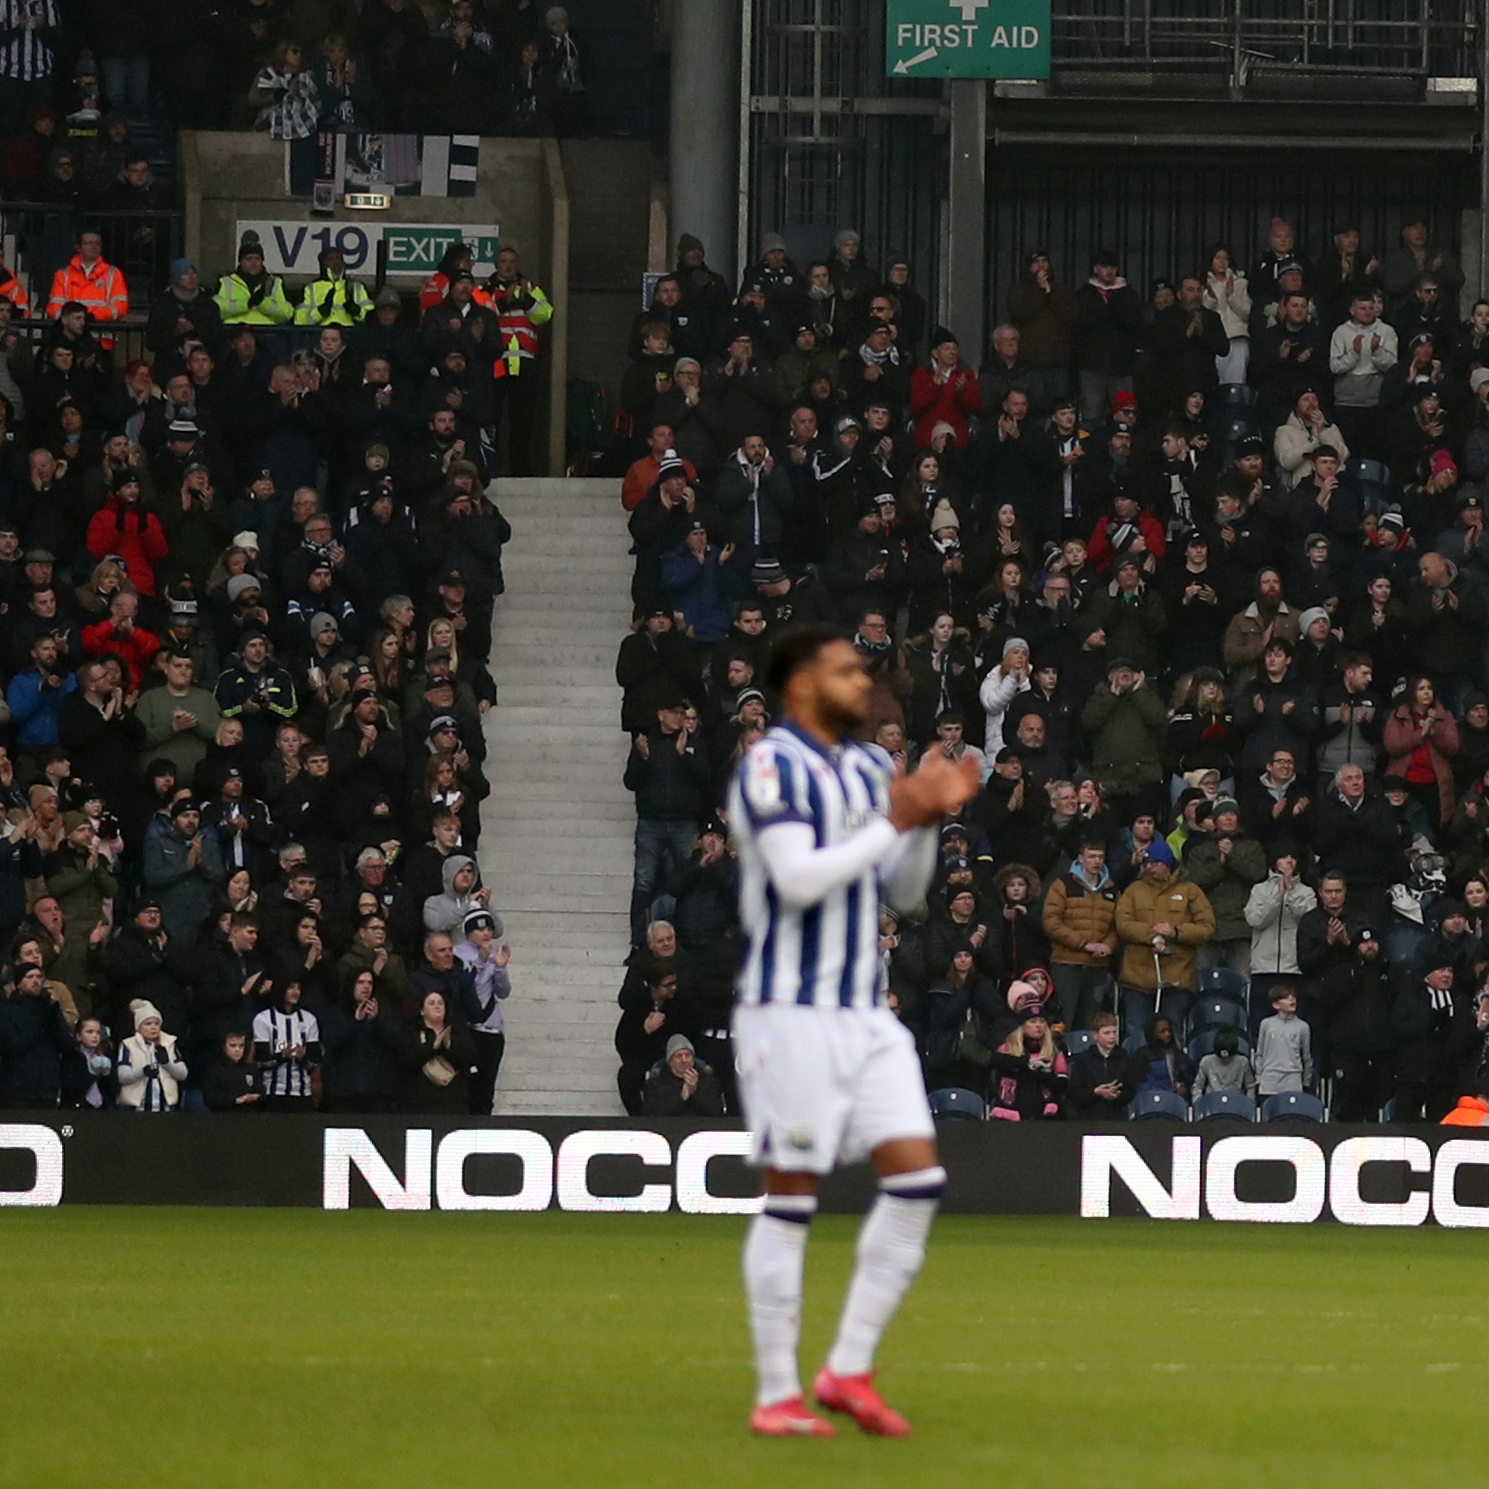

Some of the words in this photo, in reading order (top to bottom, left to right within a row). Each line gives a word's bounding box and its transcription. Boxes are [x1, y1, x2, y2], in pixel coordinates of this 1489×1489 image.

[897, 23, 979, 47] FIRST
[990, 25, 1039, 49] AID
[273, 226, 369, 270] V19
[389, 237, 456, 263] EXIT
